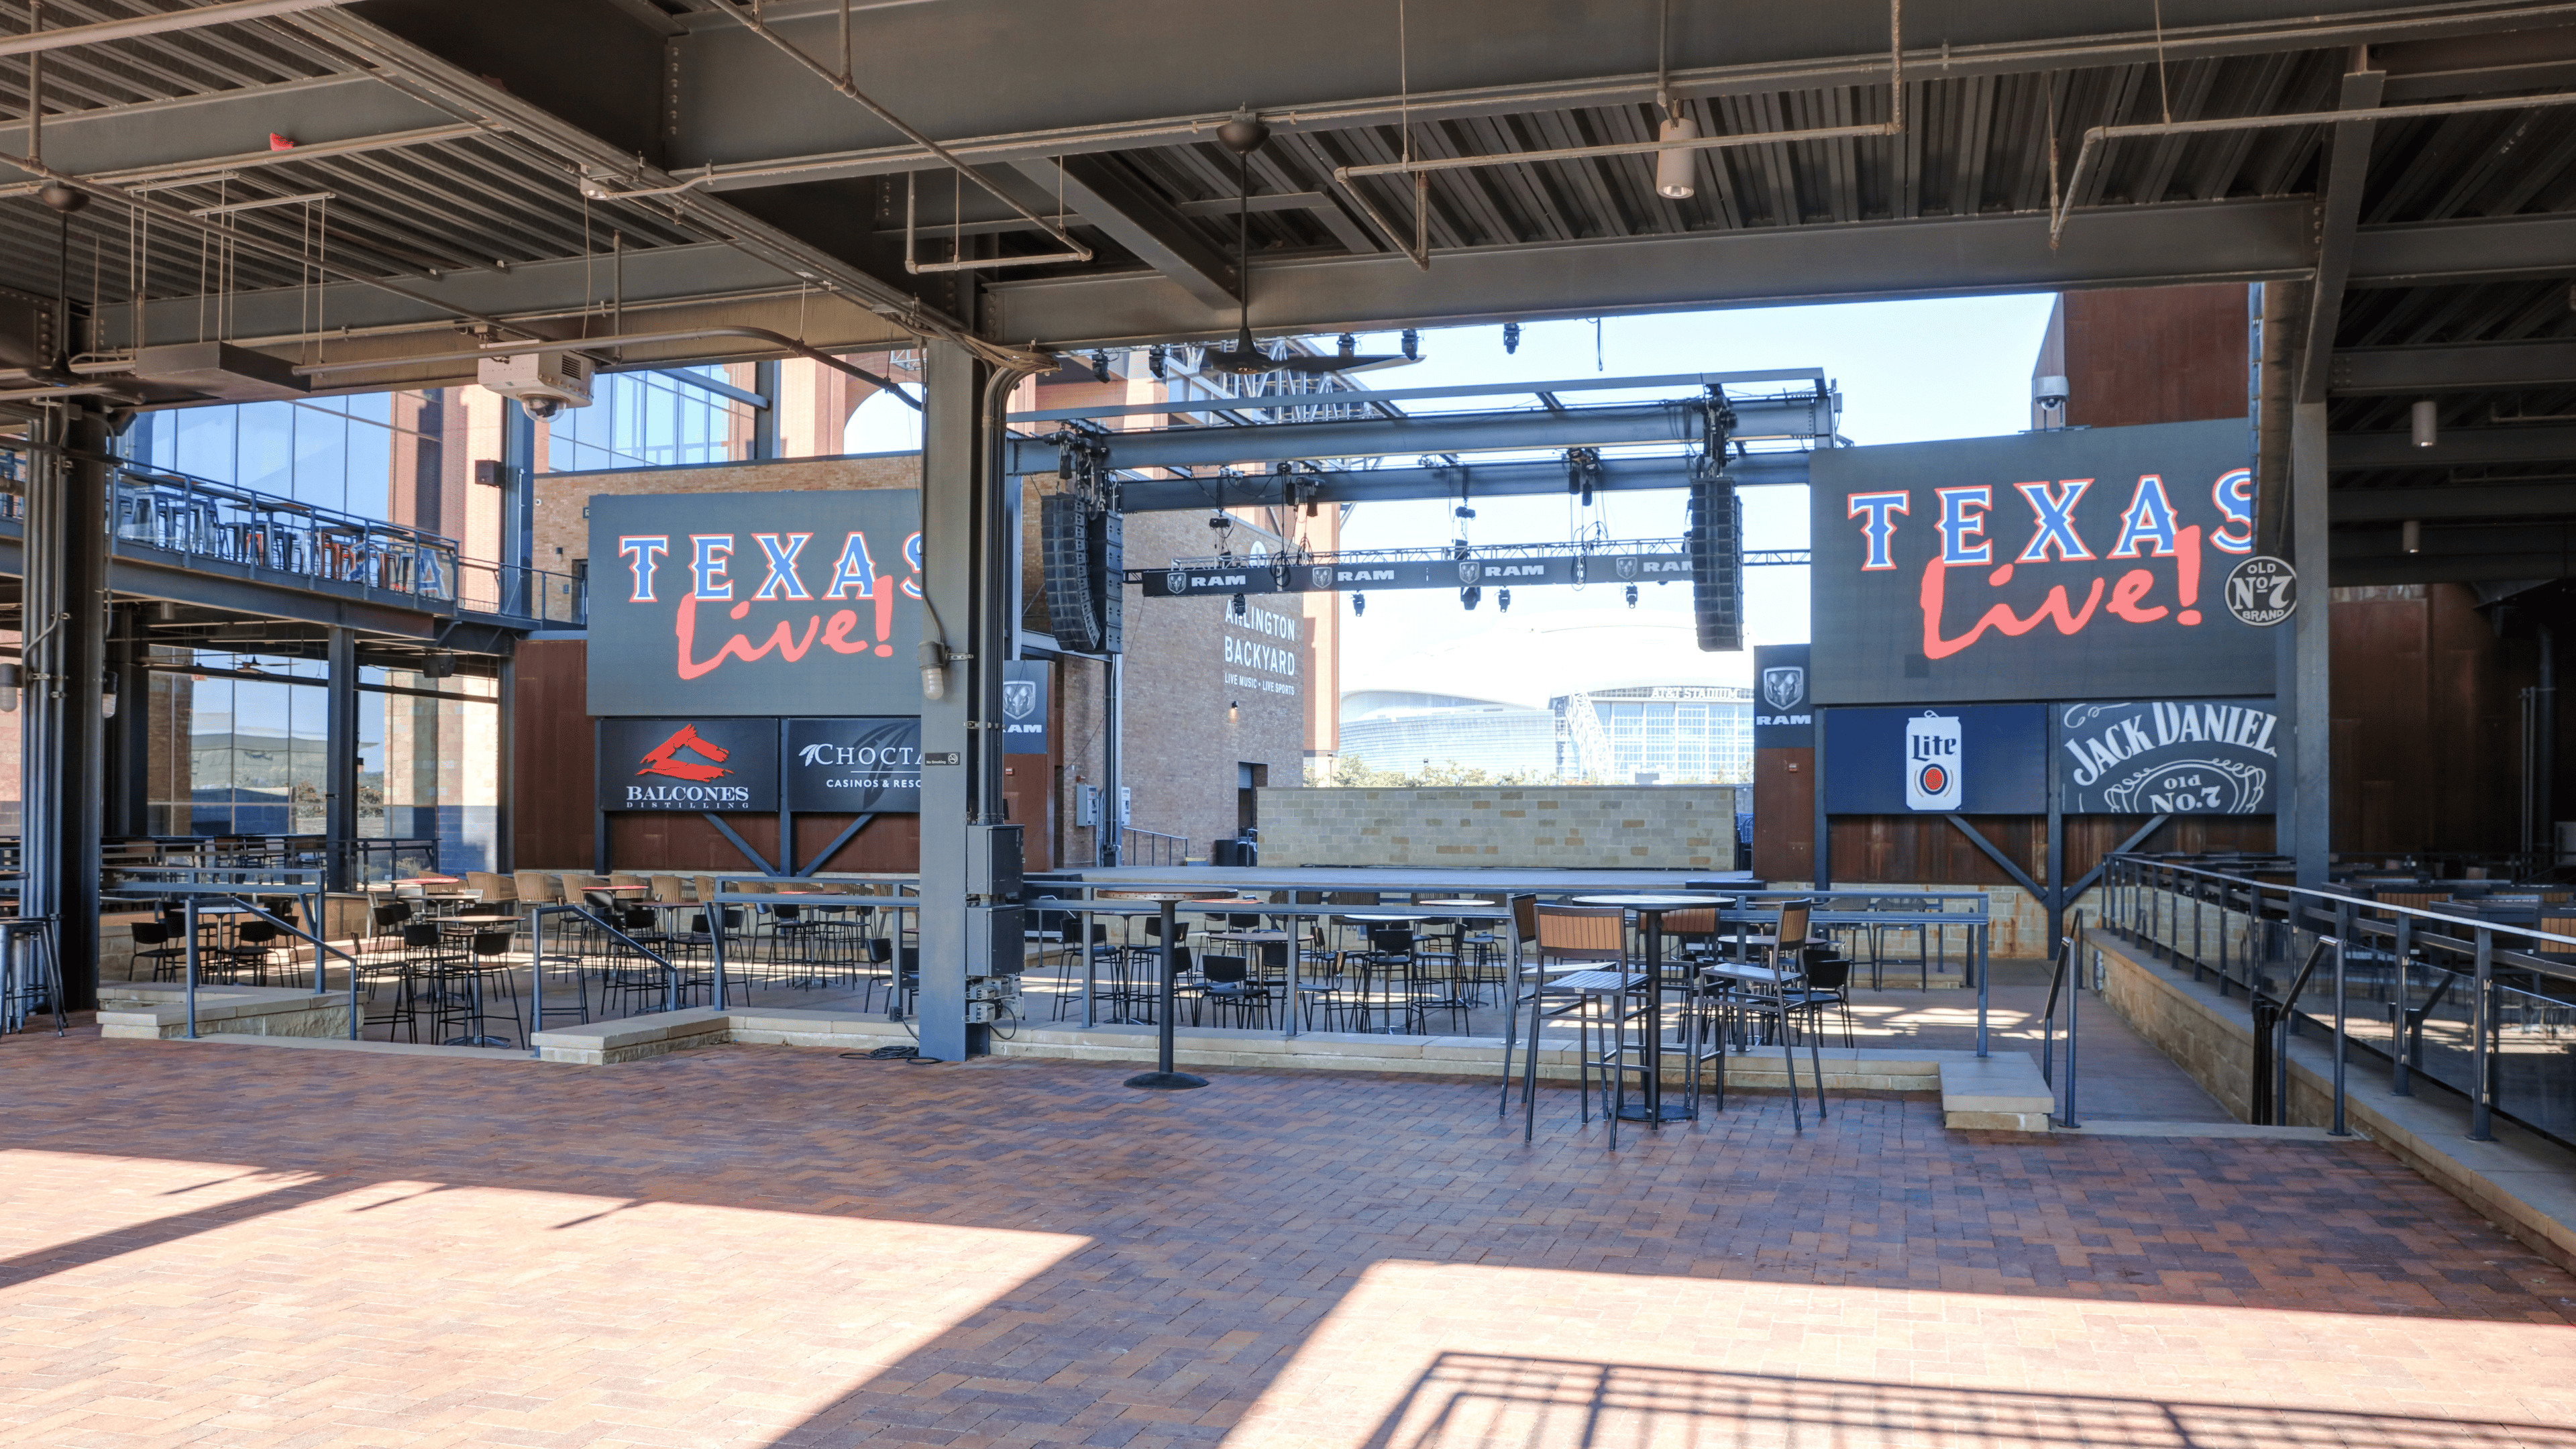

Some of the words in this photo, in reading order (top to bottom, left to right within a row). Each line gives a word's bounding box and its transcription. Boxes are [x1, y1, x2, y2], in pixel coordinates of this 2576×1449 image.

[1485, 565, 1544, 577] RAM
[1643, 561, 1693, 572] RA
[2247, 561, 2276, 574] OLD
[1191, 575, 1246, 587] RAM
[1337, 570, 1395, 582] RAM
[1920, 525, 2201, 659] Live!
[2242, 609, 2284, 622] BRAND
[676, 574, 894, 680] Live!
[1224, 635, 1295, 676] BACKYARD
[1224, 672, 1238, 686] LIVE
[1239, 675, 1257, 689] MUSIC
[1263, 680, 1275, 693] LIVE
[1275, 682, 1295, 696] SPORTS
[1651, 687, 1682, 699] AT&T
[1684, 687, 1741, 700] STADIUM
[1756, 714, 1811, 725] RAM
[1004, 724, 1042, 733] AM
[1911, 735, 1957, 762] Lite
[2064, 714, 2155, 786] JACK
[826, 779, 879, 788] CASINOS
[882, 779, 890, 788] &
[2163, 774, 2202, 790] Old
[626, 786, 749, 801] BALCONES
